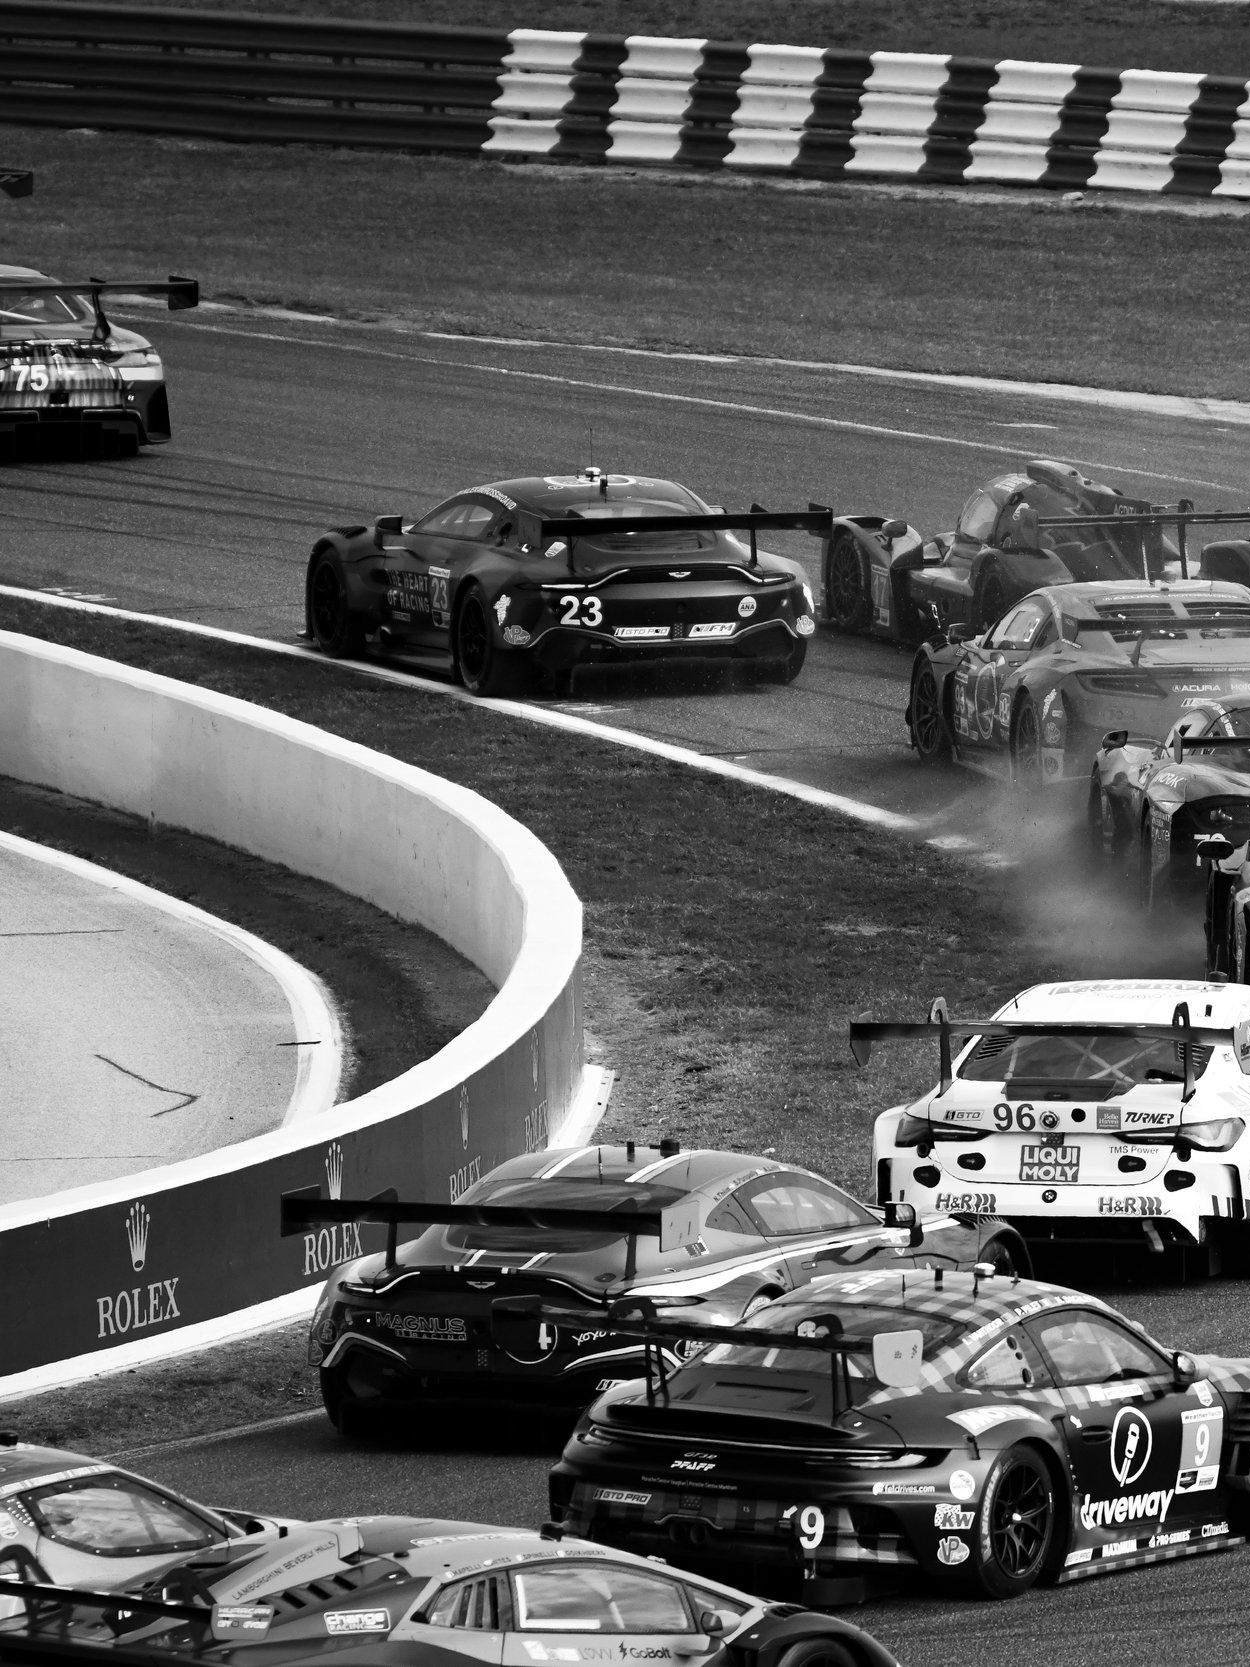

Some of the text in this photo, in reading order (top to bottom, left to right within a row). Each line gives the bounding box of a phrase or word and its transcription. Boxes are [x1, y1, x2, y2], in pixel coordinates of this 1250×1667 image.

[14, 364, 49, 391] 75
[400, 591, 430, 613] RACING
[432, 577, 448, 610] 23
[560, 596, 603, 626] 23
[1181, 684, 1221, 692] ACURA
[955, 1111, 981, 1119] GTD
[993, 1103, 1036, 1131] 96
[1124, 1111, 1175, 1124] TURNER
[1023, 1147, 1078, 1164] LIQUI
[1109, 1146, 1159, 1155] TMS Power
[1021, 1165, 1079, 1181] MOLY
[1099, 1197, 1137, 1214] H&R
[303, 1222, 364, 1275] ROLEX
[97, 1277, 181, 1338] ROLEX
[375, 1312, 466, 1333] MAGNUS
[1185, 1410, 1222, 1420] WeatherTech
[1194, 1424, 1211, 1467] 9
[670, 1460, 717, 1472] PFAFF
[603, 1490, 649, 1503] GTD PRO
[1080, 1489, 1175, 1530] driveway
[799, 1505, 825, 1550] 9
[1102, 1538, 1138, 1557] MAXIMUM
[231, 1541, 336, 1601] LAMBORGHINI BEVERLY HILLS
[326, 1613, 386, 1627] change
[629, 1647, 672, 1660] GoBolt
